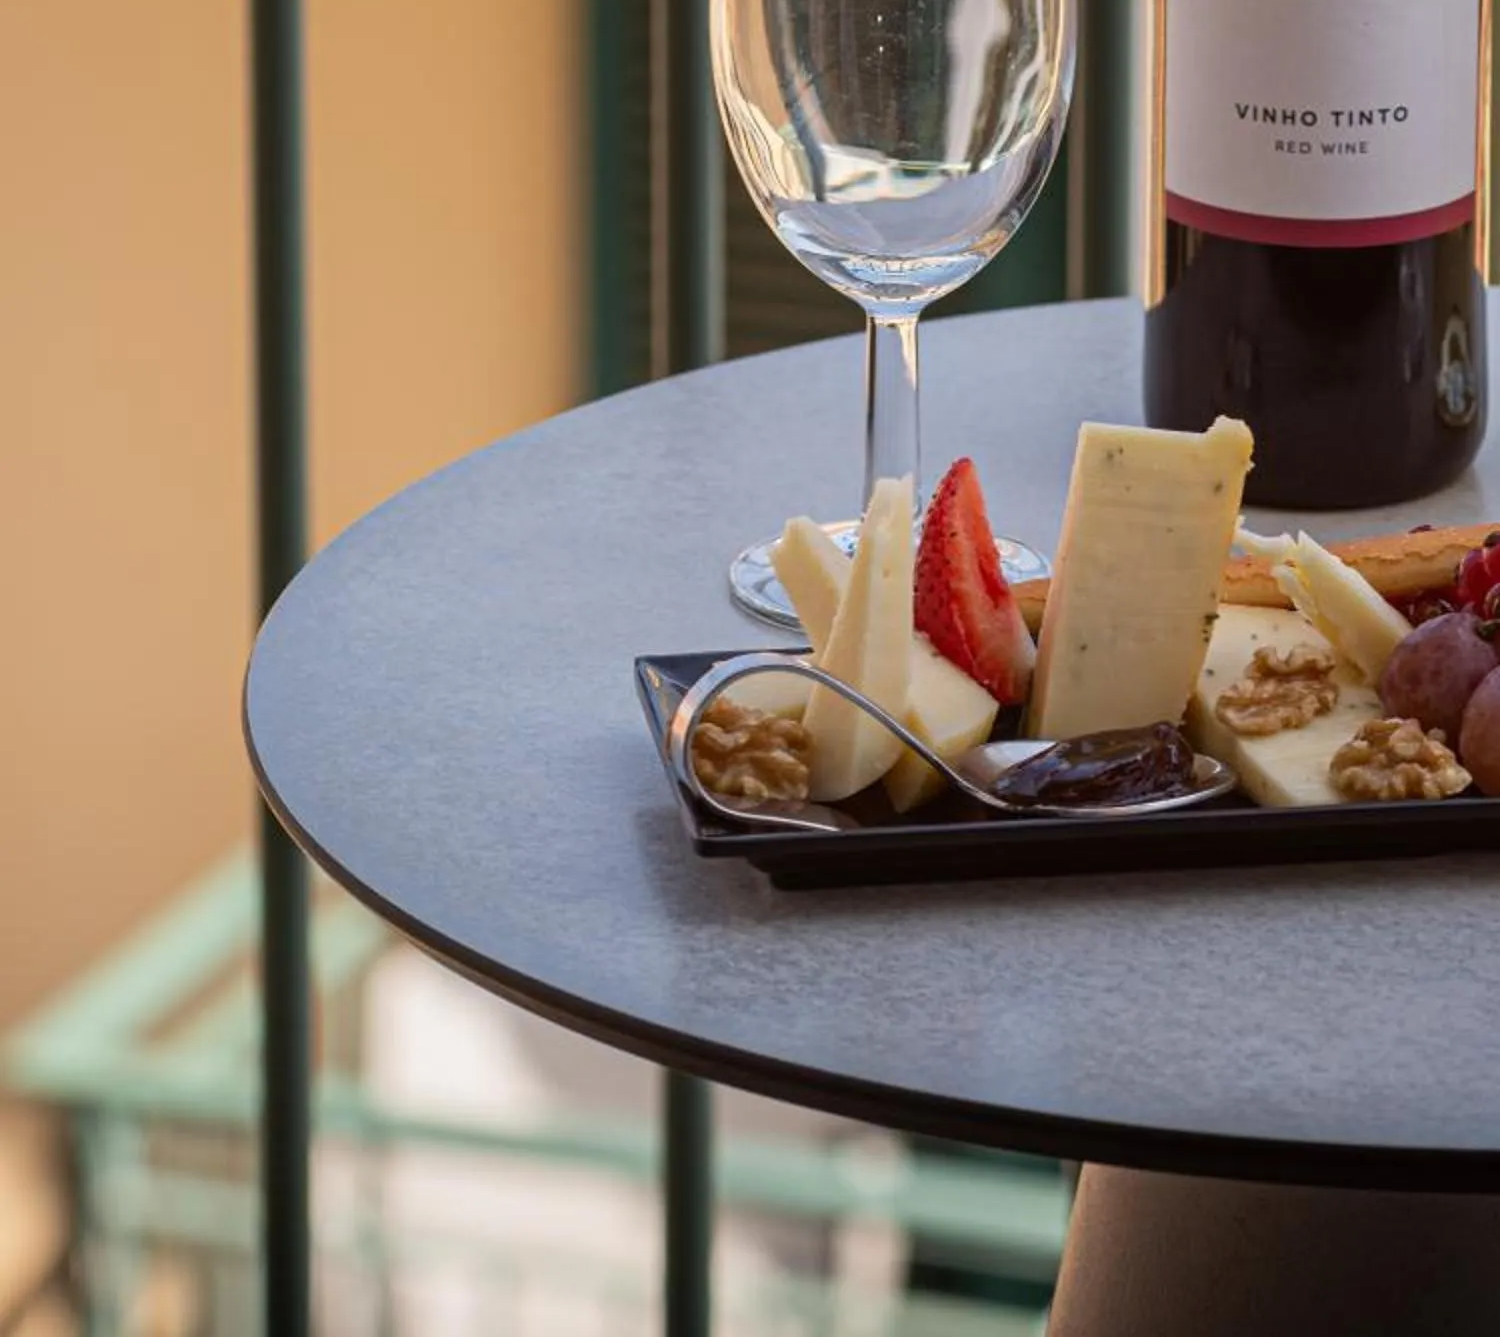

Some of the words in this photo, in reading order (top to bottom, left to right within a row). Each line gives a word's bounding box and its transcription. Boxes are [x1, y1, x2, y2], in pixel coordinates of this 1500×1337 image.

[1234, 103, 1319, 127] VINHO
[1331, 106, 1409, 127] TINTO
[1275, 140, 1312, 154] RED
[1321, 140, 1370, 155] WINE
